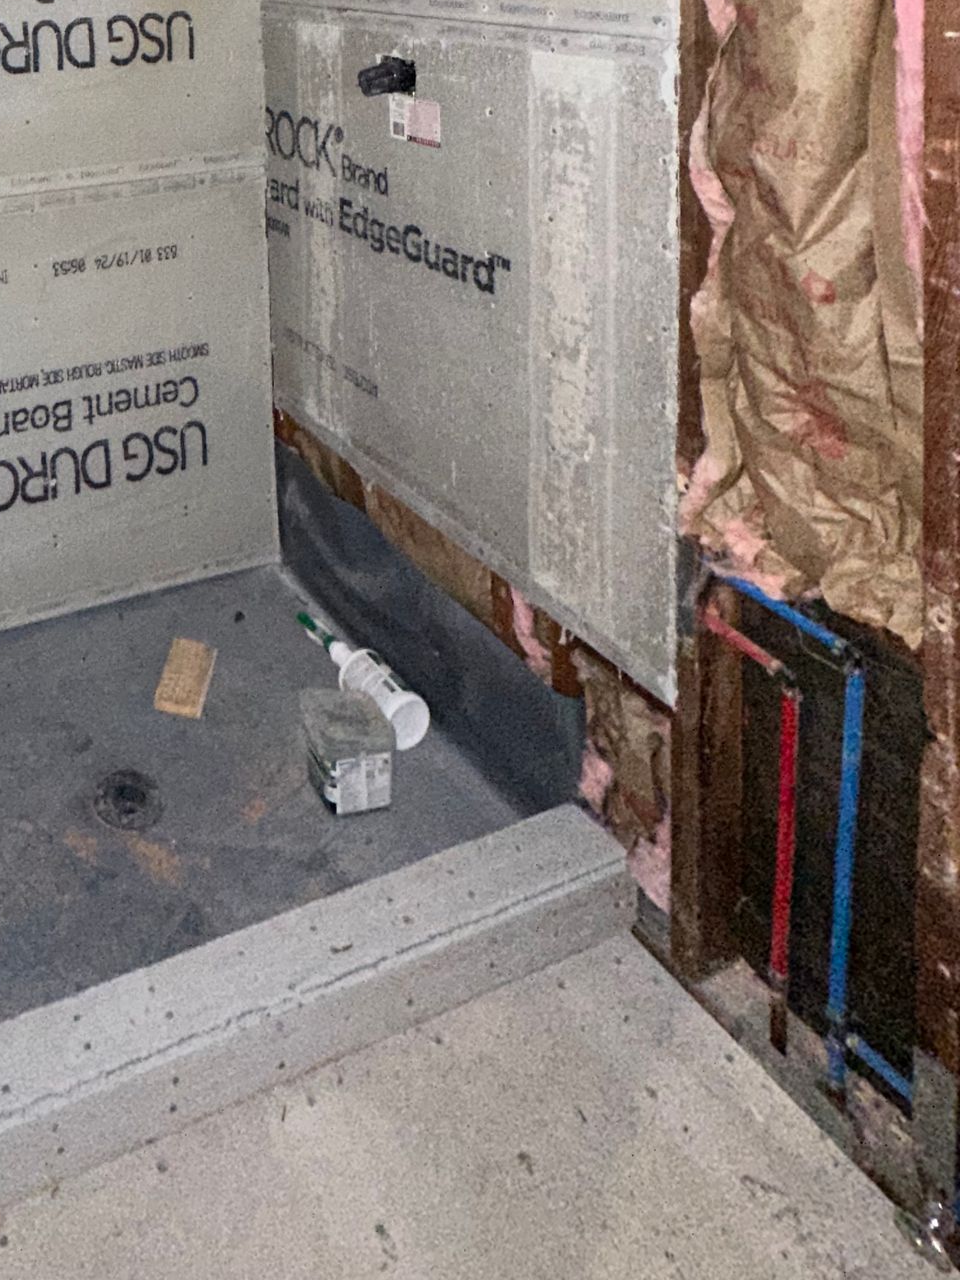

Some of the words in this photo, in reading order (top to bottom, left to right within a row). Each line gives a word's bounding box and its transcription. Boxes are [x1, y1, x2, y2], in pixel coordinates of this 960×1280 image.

[108, 10, 195, 65] USG
[341, 154, 389, 197] Brand
[303, 195, 335, 227] with
[51, 257, 87, 277] 06:53
[94, 249, 152, 270] 01/19/24
[145, 349, 166, 368] SIDE
[168, 342, 209, 362] SMOOTH
[42, 369, 65, 387] SIDE
[66, 362, 102, 381] ROUGH
[83, 375, 200, 418] Cement
[123, 420, 209, 482] USG
